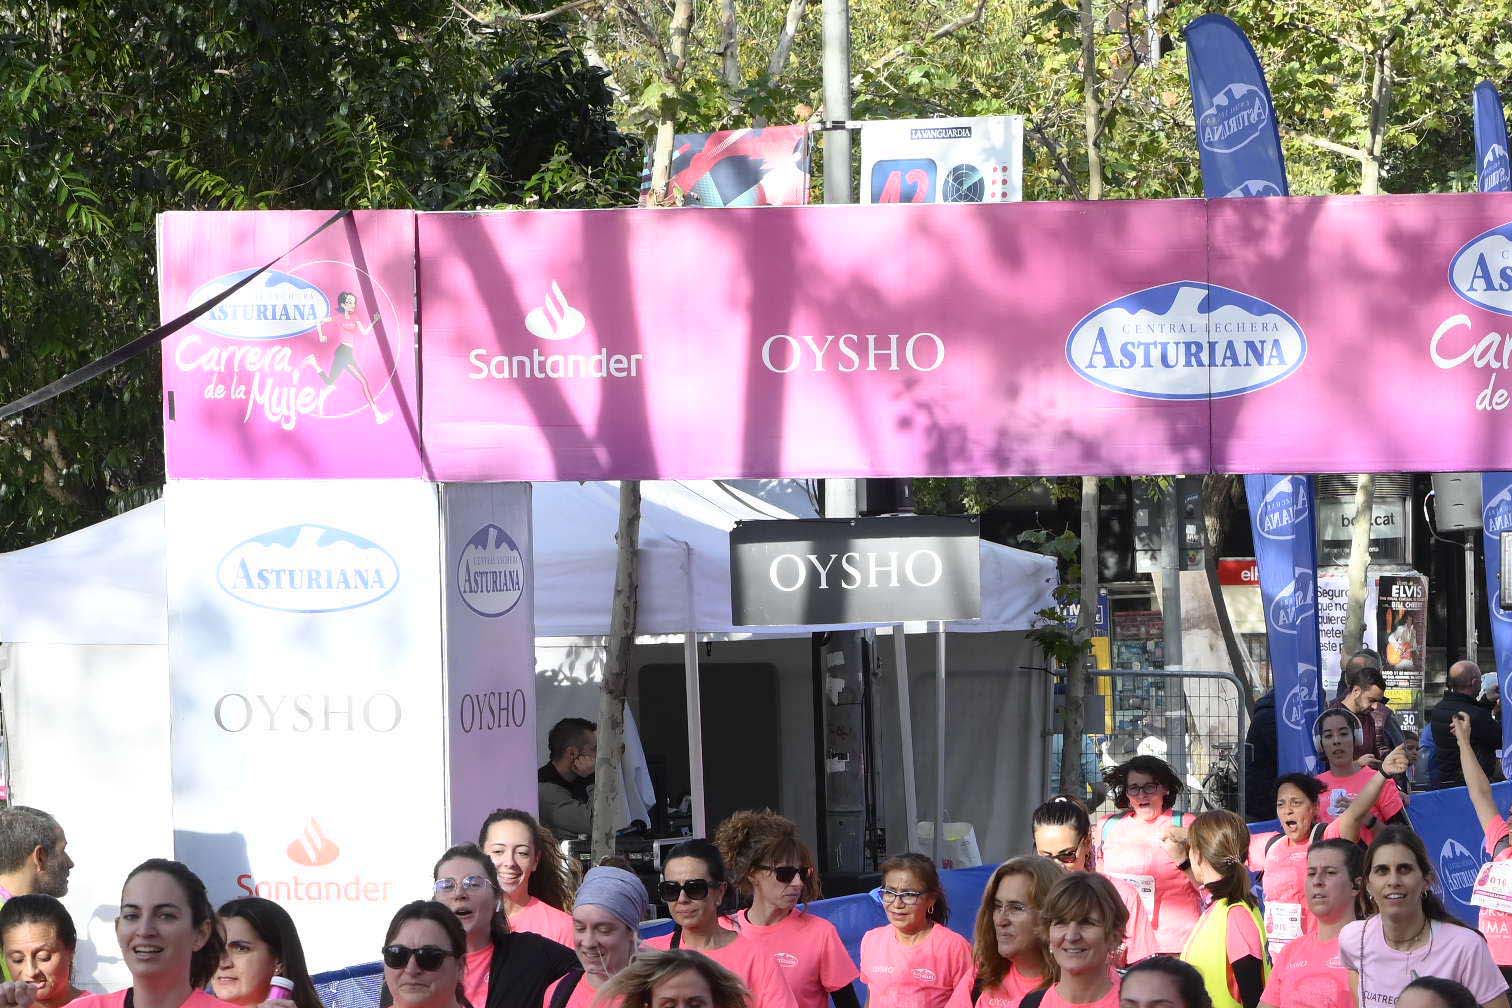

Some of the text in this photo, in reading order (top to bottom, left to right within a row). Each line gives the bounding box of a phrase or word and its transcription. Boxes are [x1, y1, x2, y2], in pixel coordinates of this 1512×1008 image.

[1122, 321, 1280, 335] CENTRAL LECHERA
[175, 336, 293, 373] Carrera
[469, 348, 643, 379] Santander
[761, 332, 946, 373] OYSHO
[1086, 326, 1288, 369] ASTURIANA
[205, 370, 337, 430] de la Mujer
[1475, 374, 1510, 411] de
[232, 558, 387, 590] ASTURIANA
[463, 566, 520, 596] ASTURIANA
[769, 548, 944, 592] OYSHO
[1391, 585, 1423, 598] ELVIS
[214, 693, 402, 733] OYSHO
[460, 688, 527, 734] OYSHO
[236, 874, 392, 903] Santander
